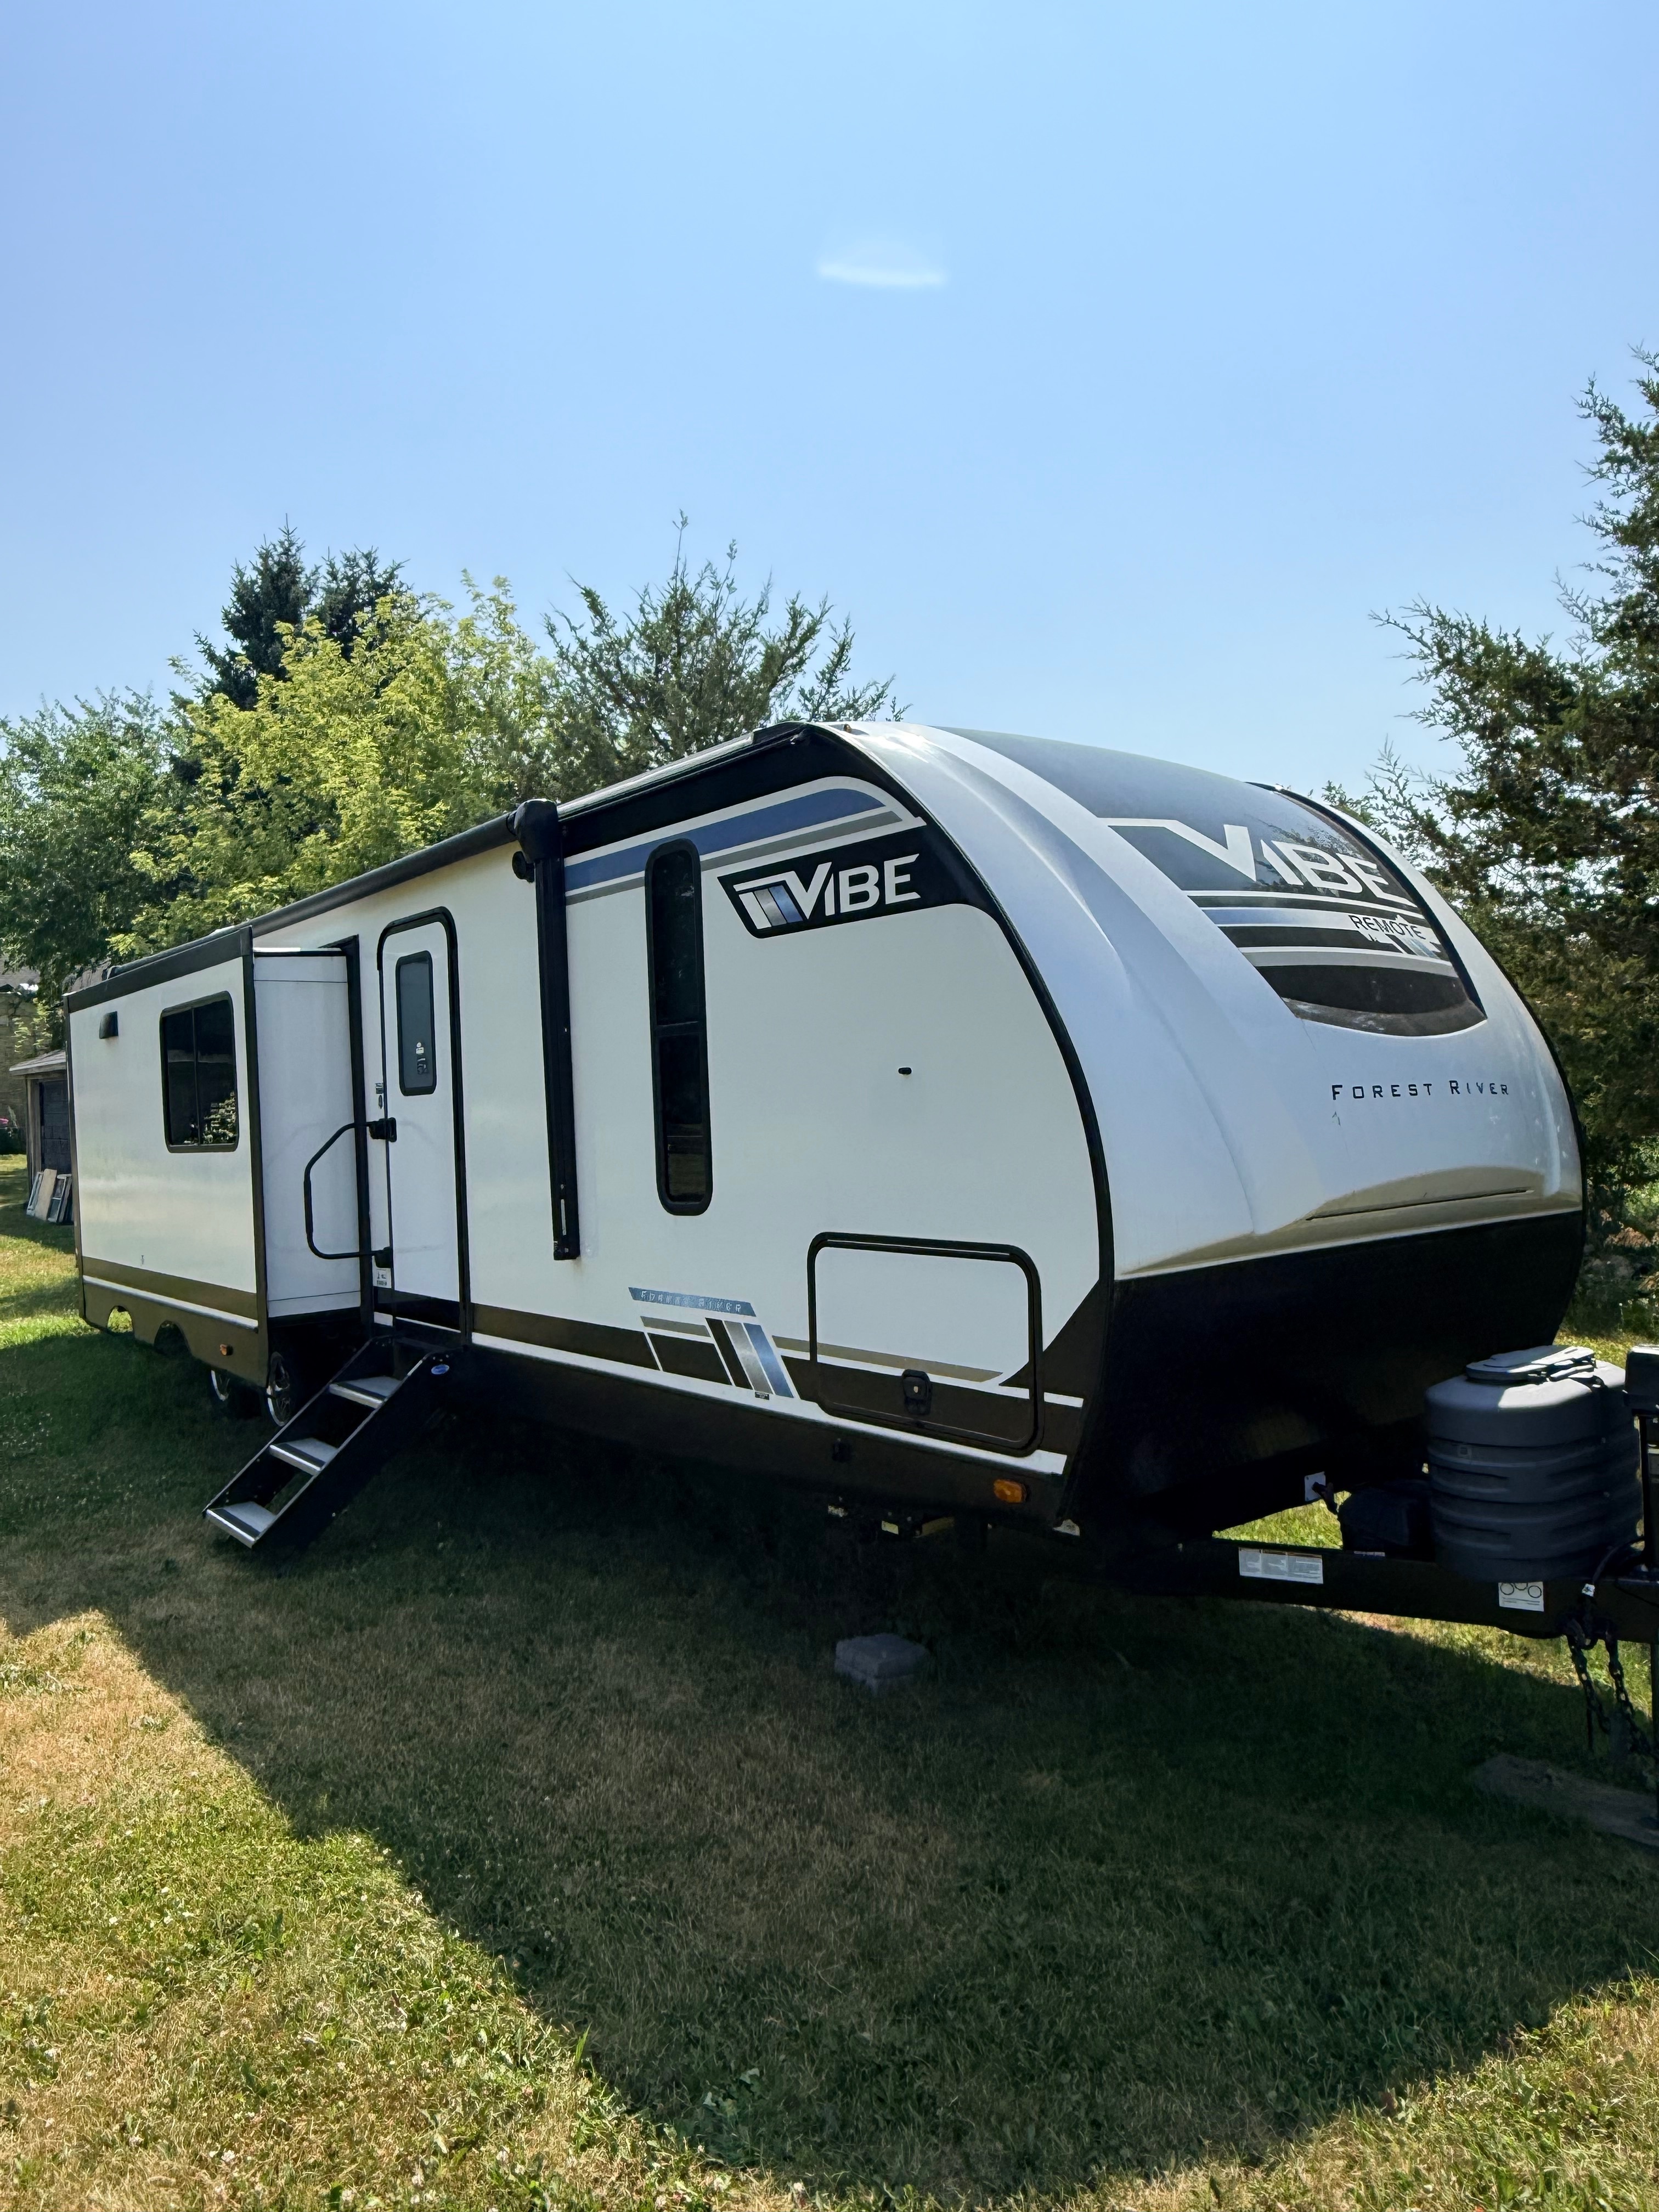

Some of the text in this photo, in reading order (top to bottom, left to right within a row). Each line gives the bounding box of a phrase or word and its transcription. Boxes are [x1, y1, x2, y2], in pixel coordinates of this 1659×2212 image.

[1108, 817, 1418, 908] VIBE
[733, 853, 921, 921] VIBE
[1348, 914, 1426, 940] REMOTE
[1331, 1080, 1509, 1101] FOREST RIVER
